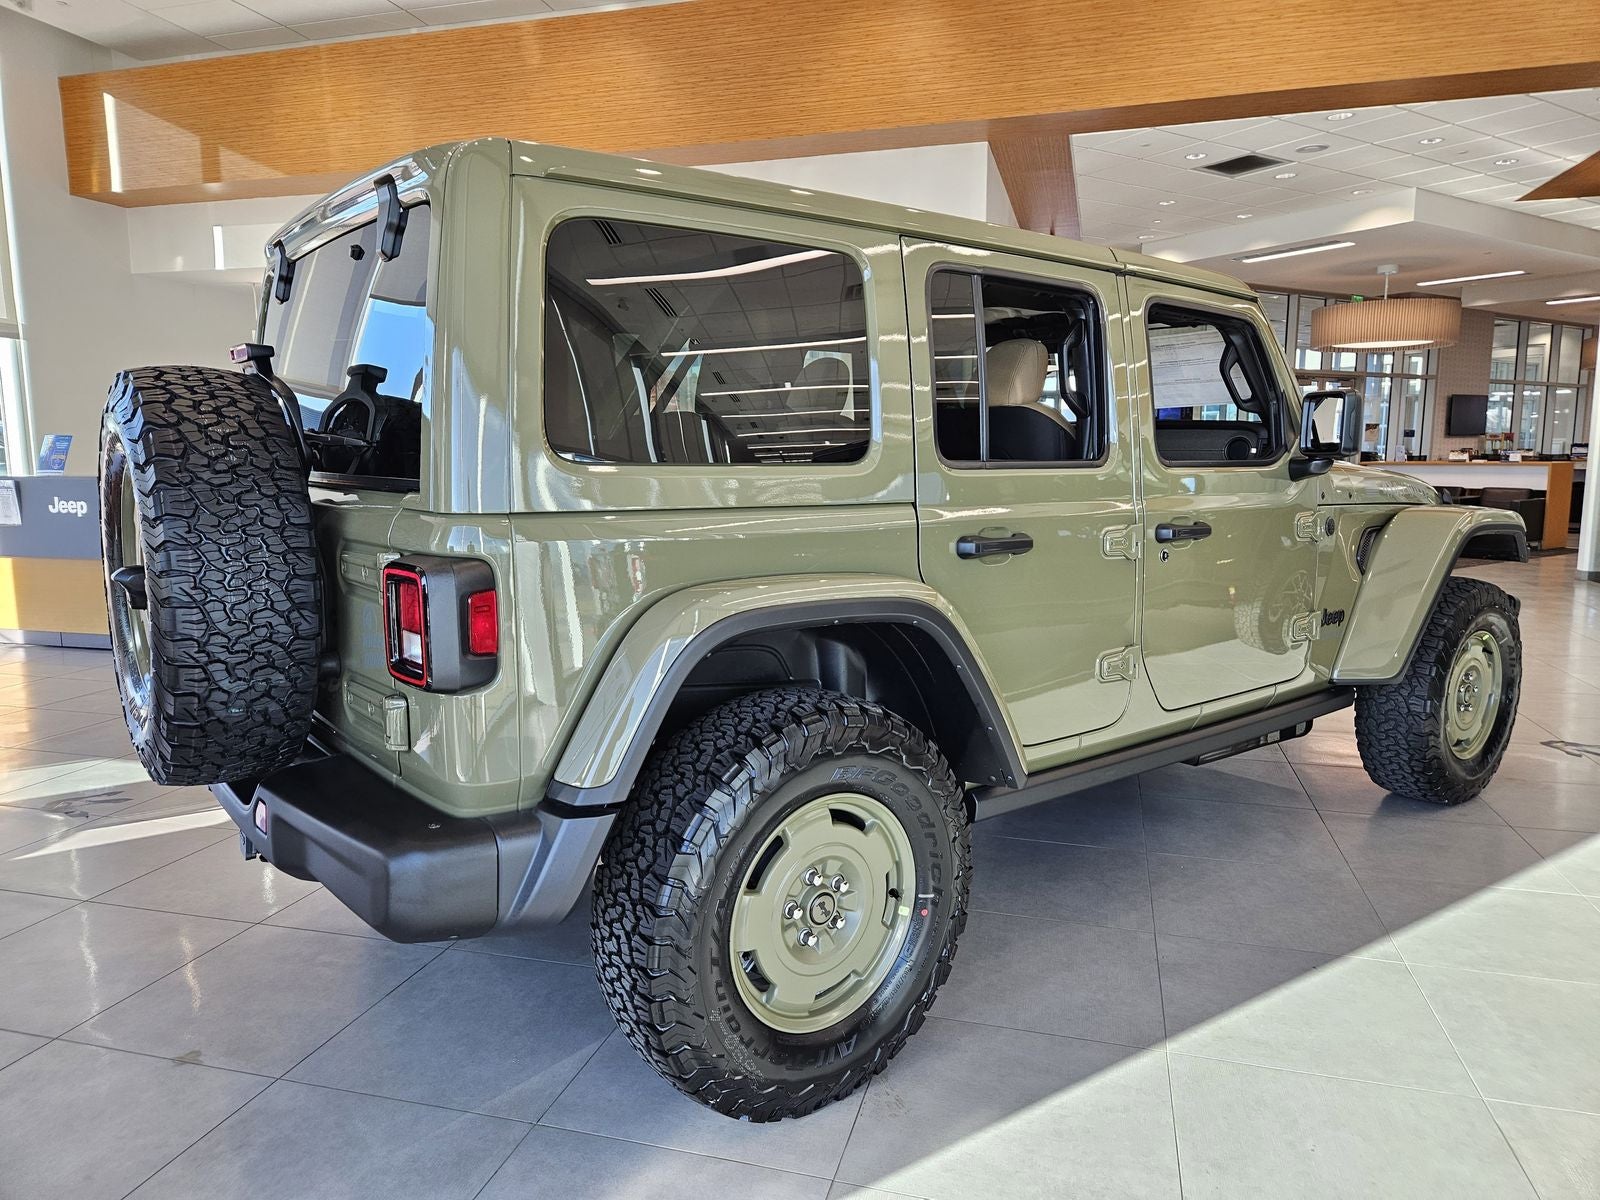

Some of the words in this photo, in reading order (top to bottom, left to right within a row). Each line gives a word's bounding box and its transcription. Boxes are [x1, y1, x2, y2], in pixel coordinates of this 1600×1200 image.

[48, 496, 88, 517] Jeep
[1320, 608, 1345, 627] Jeep
[830, 765, 944, 908] BFGoodrich
